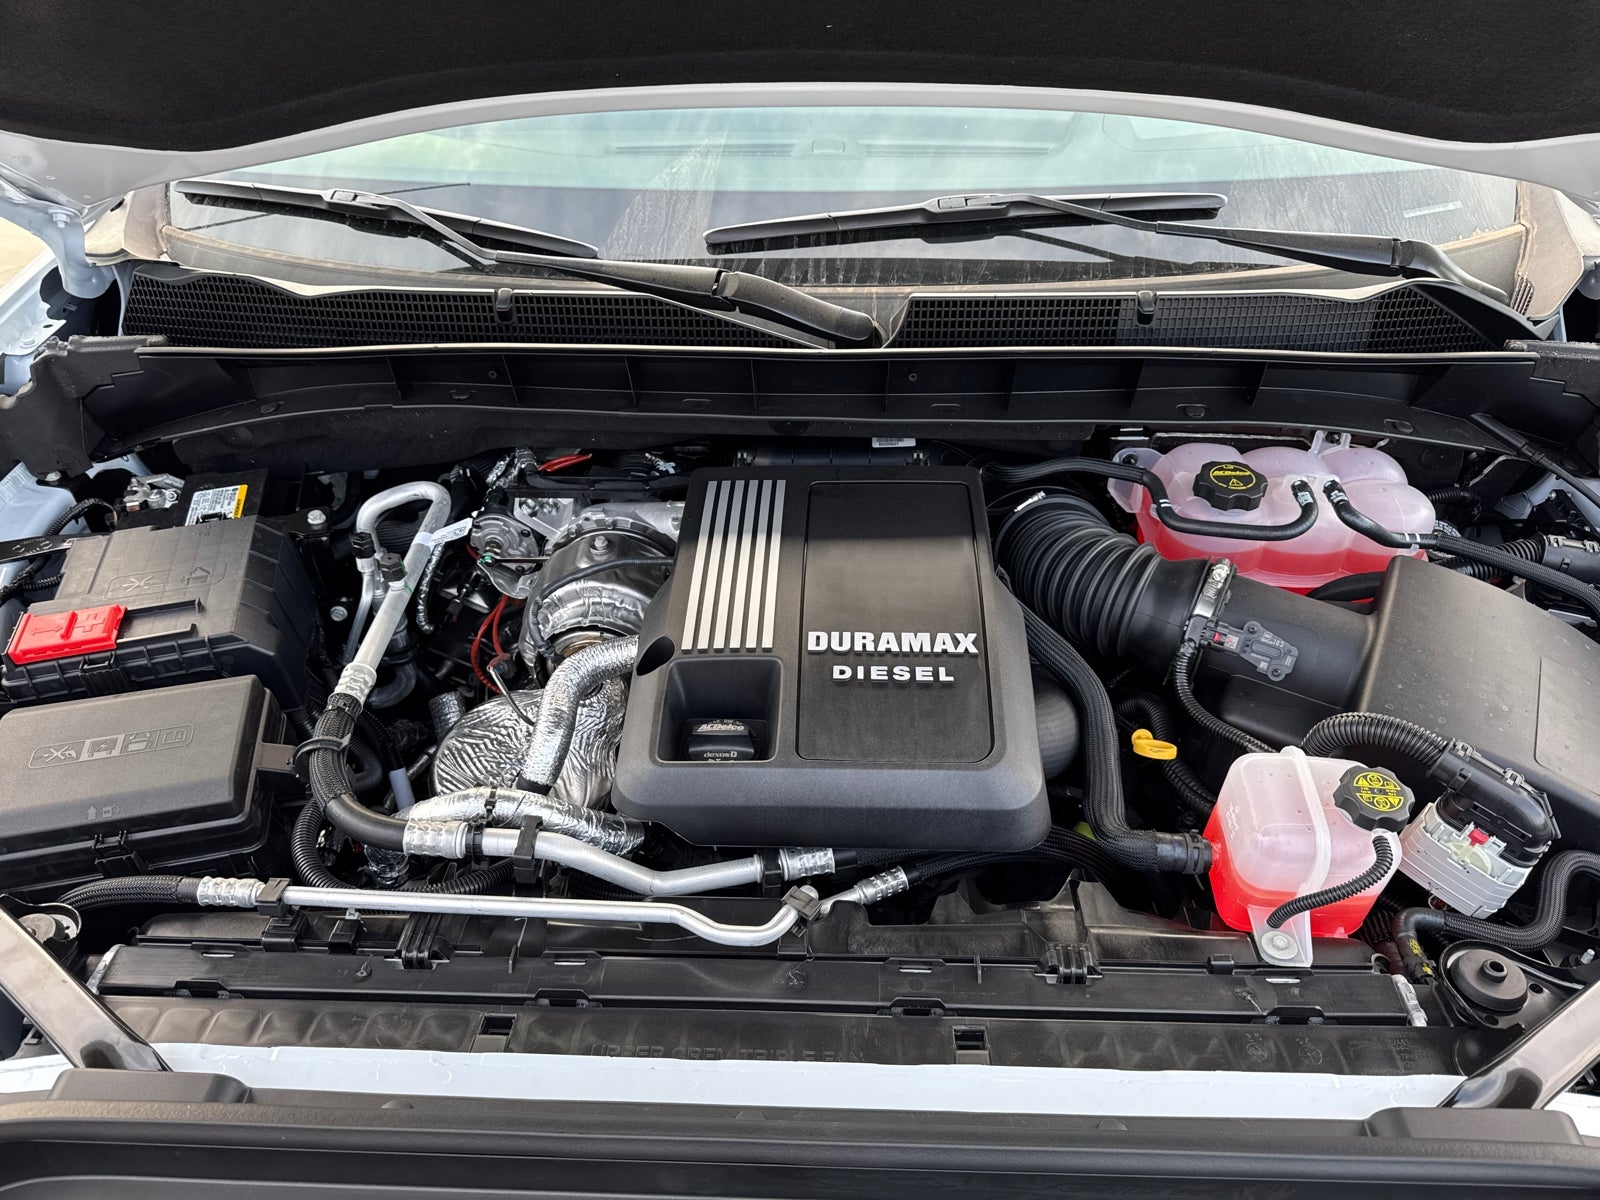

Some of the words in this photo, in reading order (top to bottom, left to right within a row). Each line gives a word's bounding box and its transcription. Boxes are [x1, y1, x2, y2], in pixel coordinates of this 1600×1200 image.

[807, 631, 979, 655] DURAMAX
[832, 665, 955, 683] DIESEL
[697, 723, 745, 733] ACDelco
